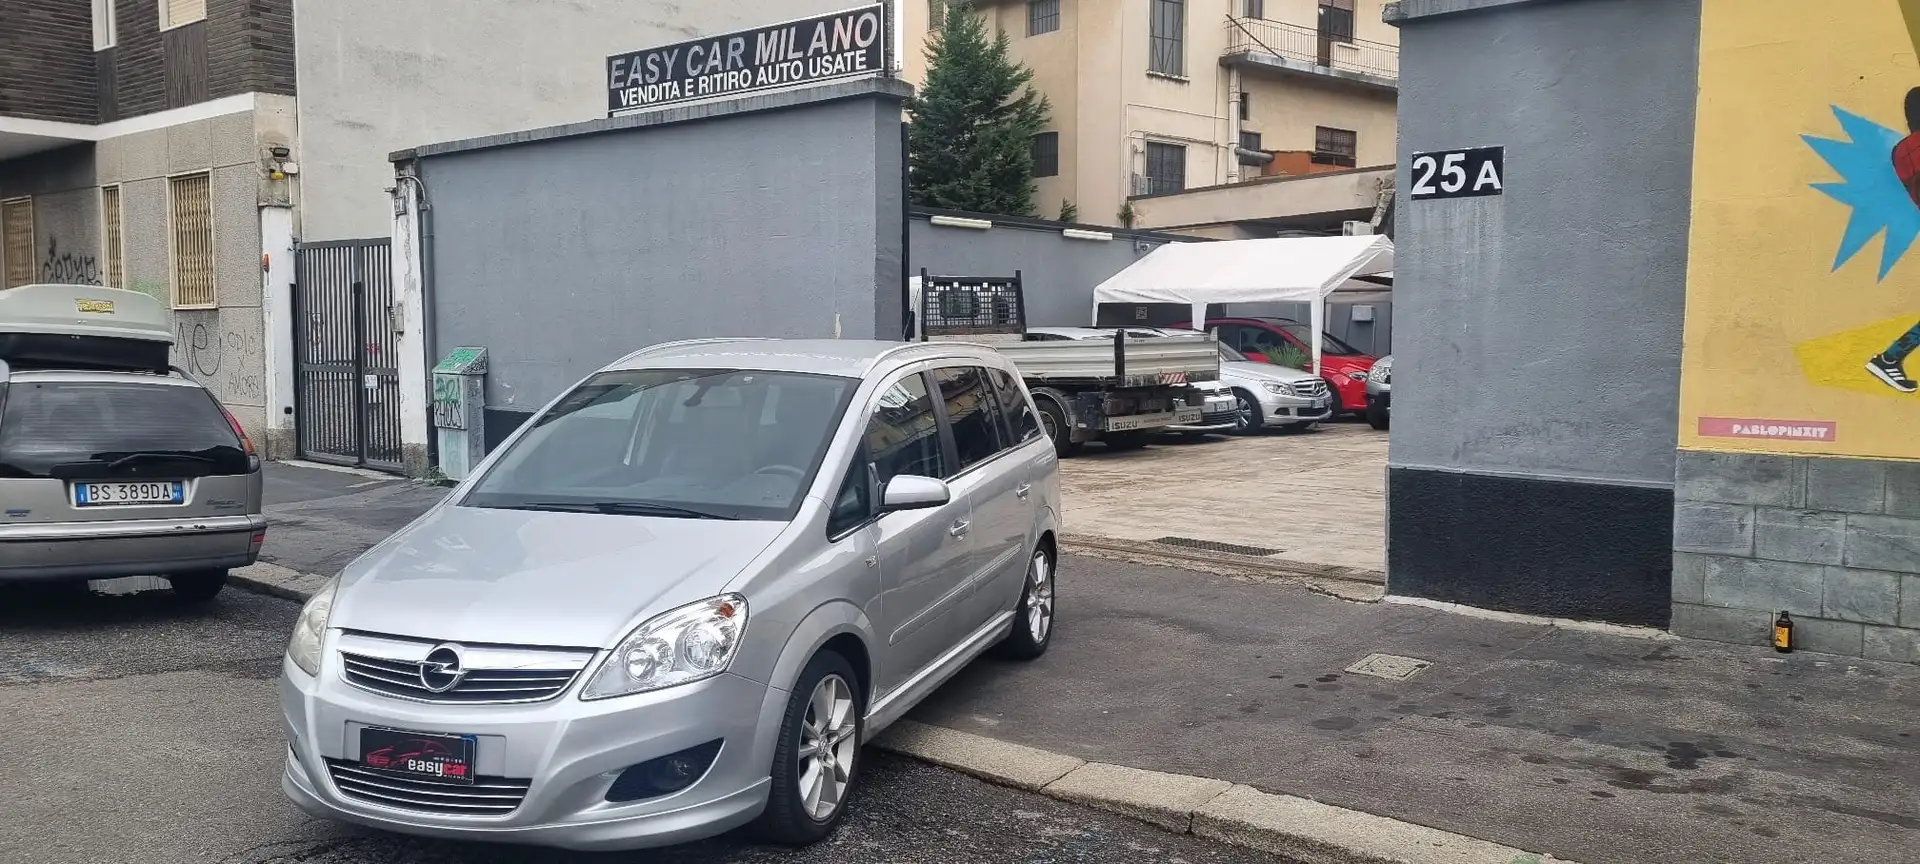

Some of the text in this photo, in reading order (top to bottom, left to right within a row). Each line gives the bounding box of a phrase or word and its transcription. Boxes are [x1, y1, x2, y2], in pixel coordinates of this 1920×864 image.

[610, 12, 878, 90] EASY CAR MILANO
[619, 49, 868, 107] VENDITA E RITIRO AUTO USATE
[1111, 420, 1138, 430] ISUZU
[1179, 413, 1200, 422] ISUZU
[1732, 424, 1829, 438] PABLOPINXIT
[89, 484, 112, 501] BS
[118, 483, 171, 500] 389DA
[408, 758, 468, 777] easycar
